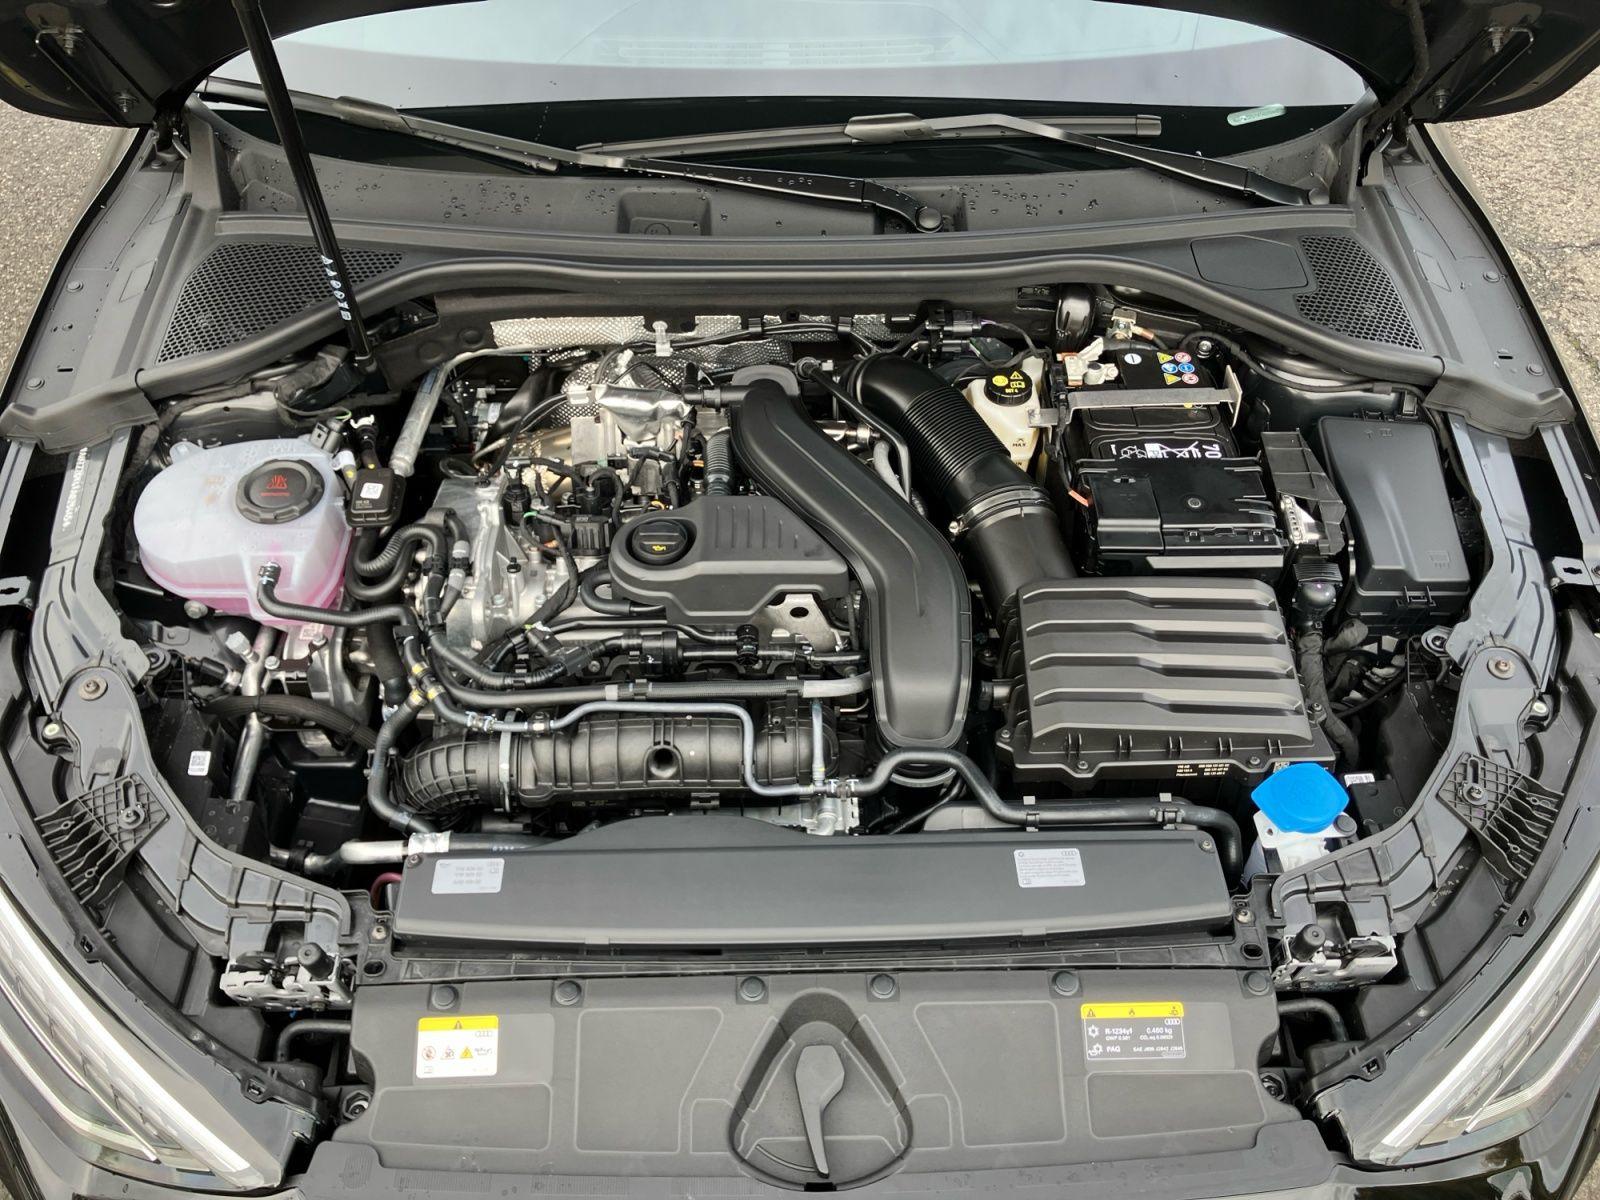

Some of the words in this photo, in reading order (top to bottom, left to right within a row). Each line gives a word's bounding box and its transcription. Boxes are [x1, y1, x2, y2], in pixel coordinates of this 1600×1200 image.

[1202, 444, 1222, 459] 70
[1164, 1027, 1173, 1036] kg
[1106, 1045, 1121, 1053] PAG
